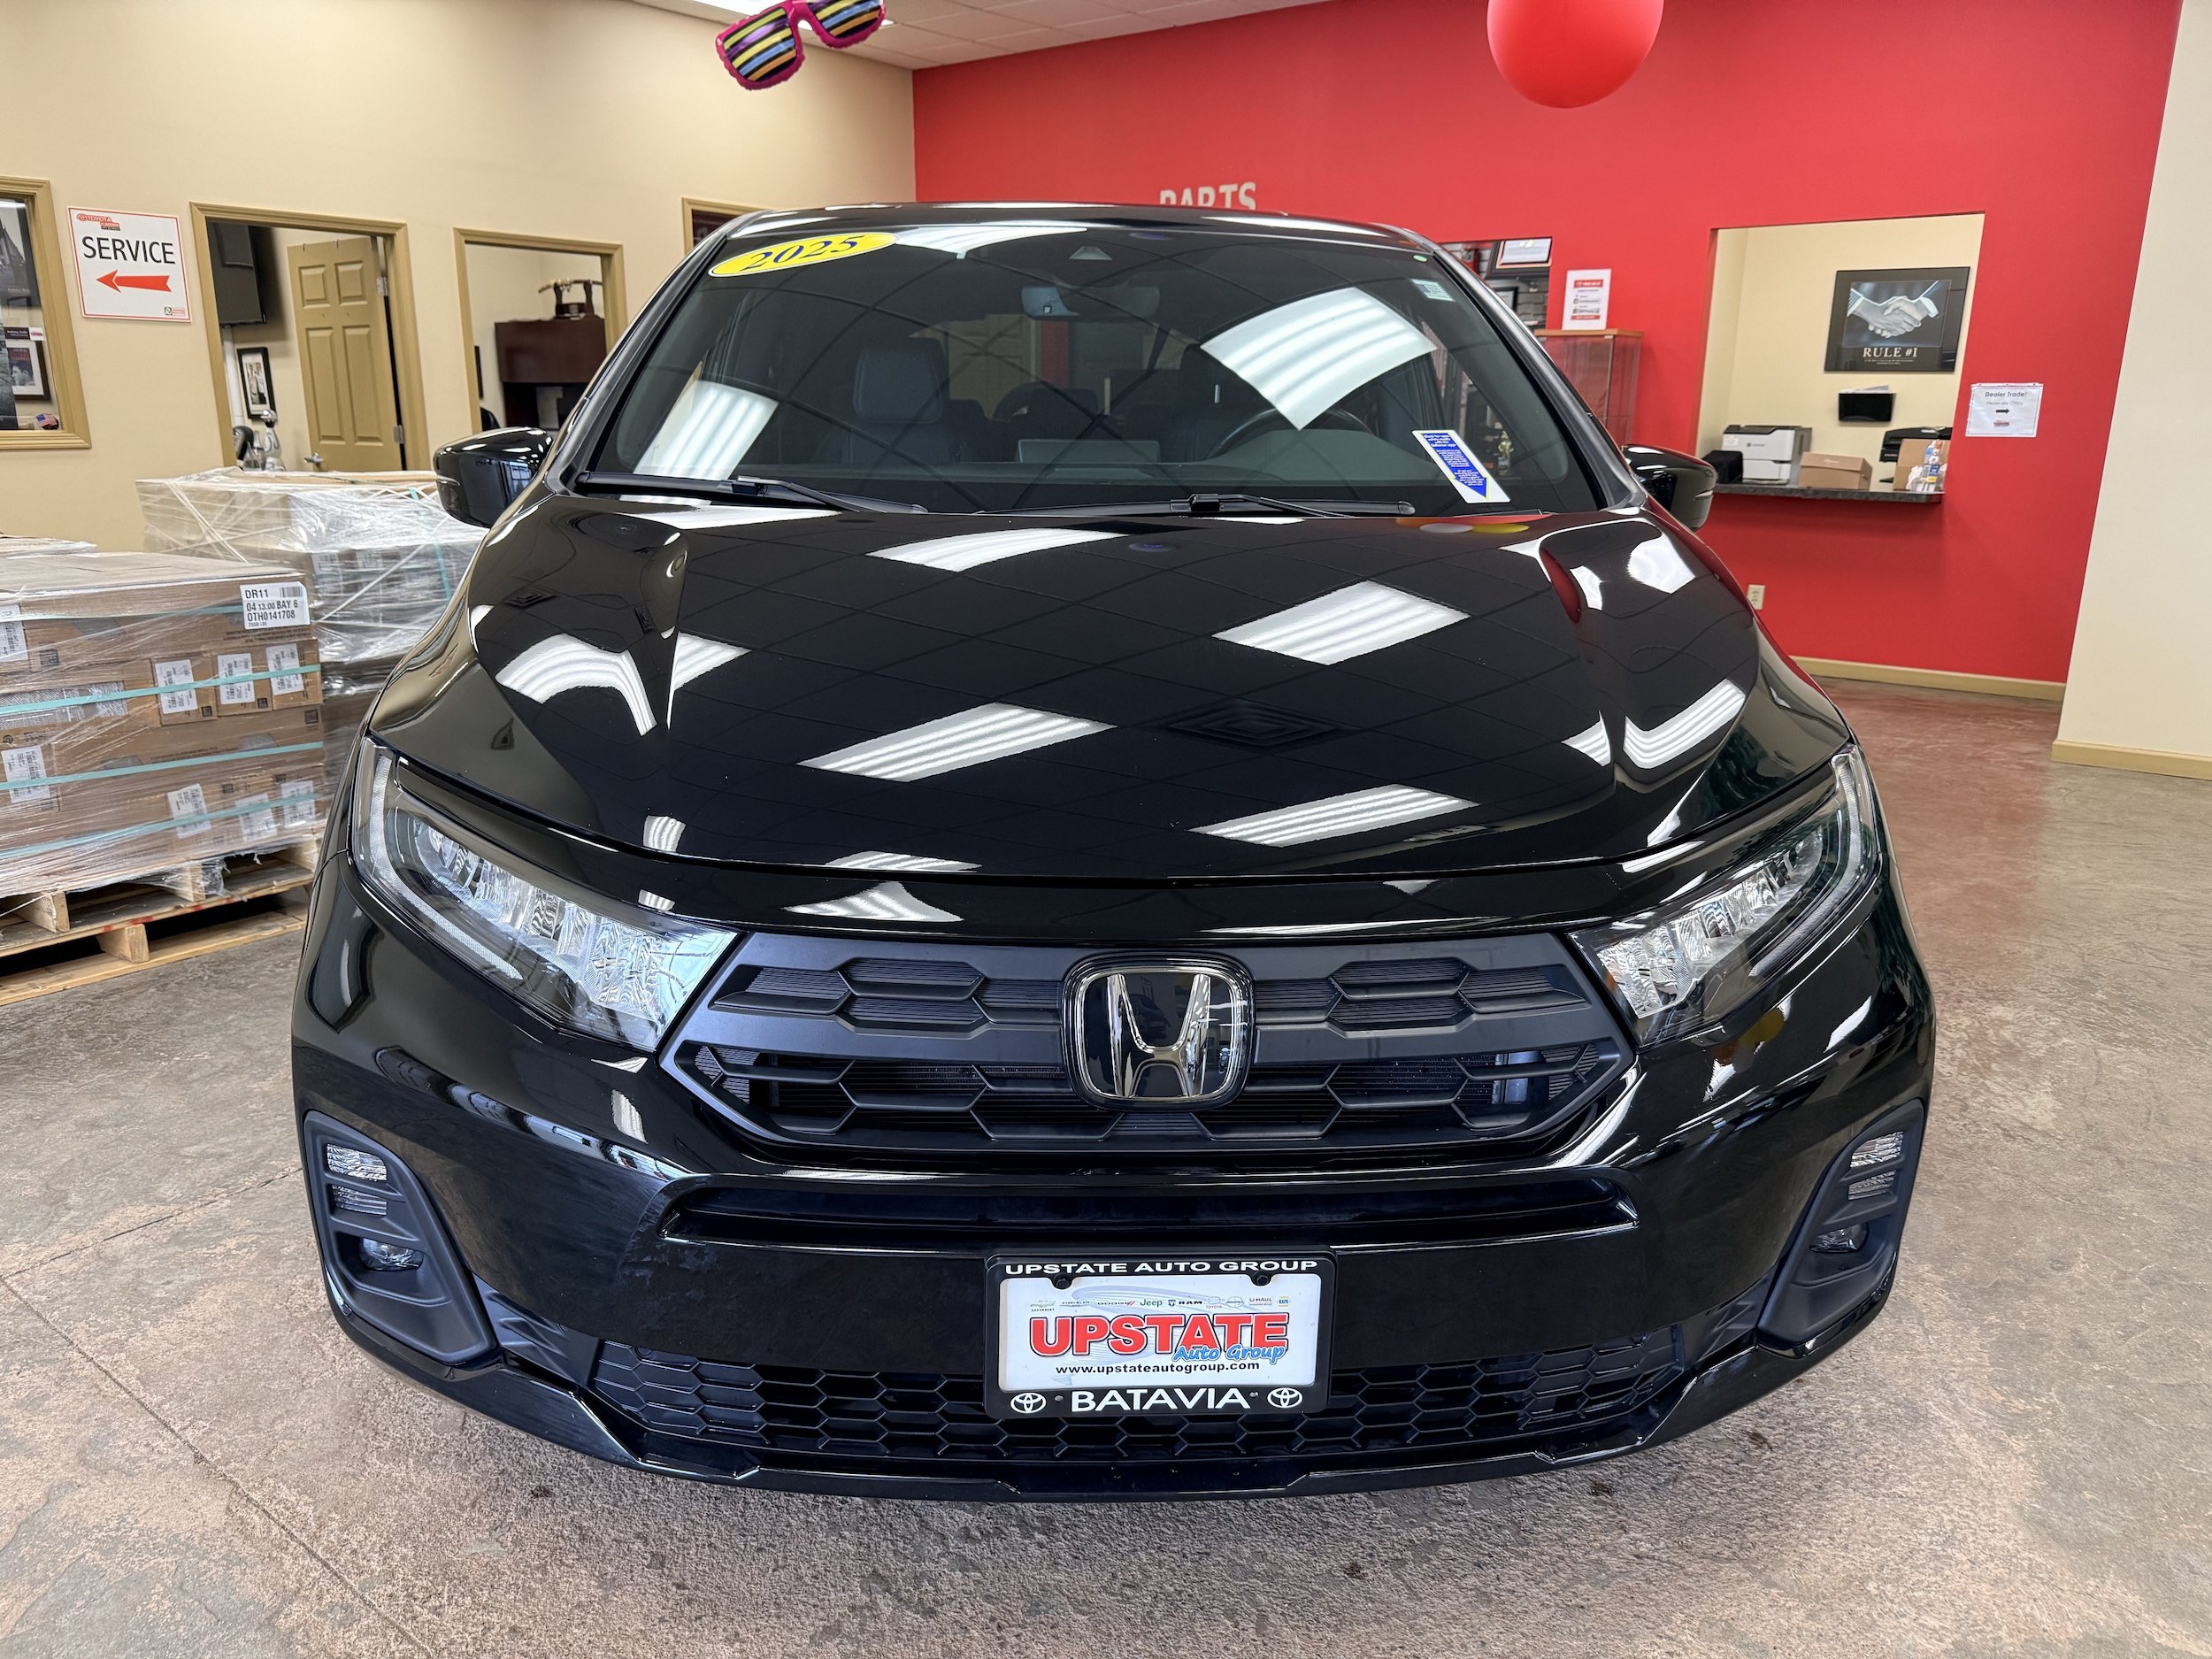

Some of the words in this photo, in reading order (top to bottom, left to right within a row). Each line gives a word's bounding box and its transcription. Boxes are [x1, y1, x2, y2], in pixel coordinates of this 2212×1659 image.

[81, 235, 176, 265] SERVICE
[739, 234, 865, 272] 2025
[1863, 347, 1902, 357] RULE
[1905, 347, 1918, 357] #1
[245, 589, 268, 598] DR11
[246, 603, 257, 611] 04
[276, 600, 291, 610] BAY
[1005, 1263, 1128, 1275] UPSTATE
[1133, 1261, 1211, 1273] AUTO
[1218, 1260, 1318, 1271] GROUP
[1140, 1298, 1163, 1308] Jeep
[1030, 1312, 1289, 1356] UPSTATE
[1172, 1345, 1221, 1362] Auto
[1225, 1344, 1287, 1364] Group
[1056, 1362, 1260, 1375] www.upstateautogroup.com
[1071, 1387, 1251, 1413] BATAVIA
